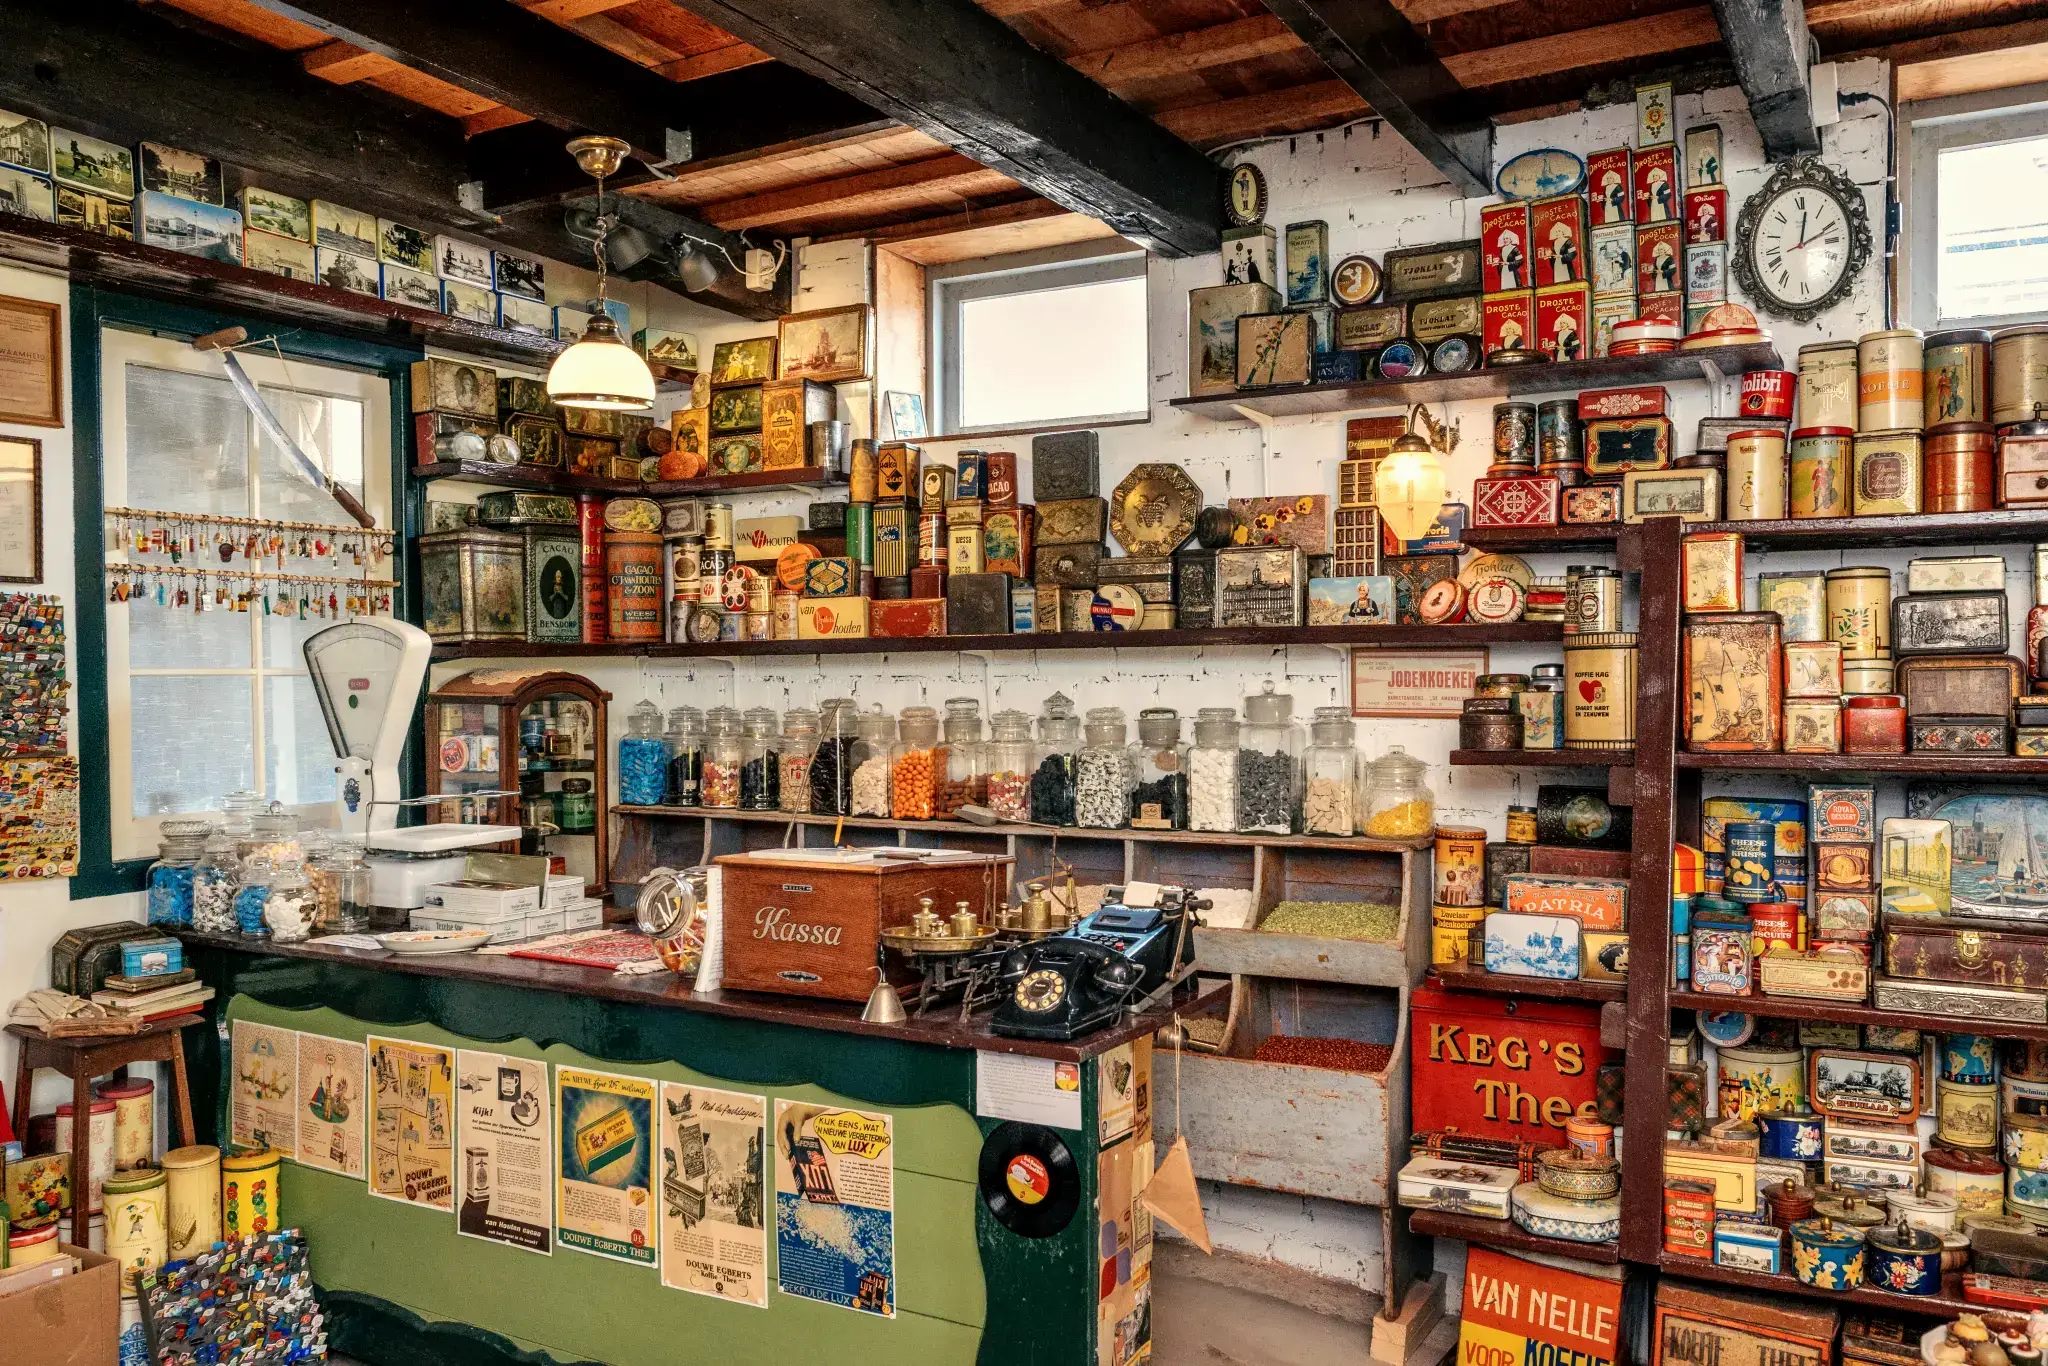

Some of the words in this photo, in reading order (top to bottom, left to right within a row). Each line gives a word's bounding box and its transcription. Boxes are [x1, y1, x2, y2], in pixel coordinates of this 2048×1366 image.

[1602, 161, 1627, 170] CACAO
[1647, 158, 1673, 167] CACAO
[1549, 211, 1578, 221] CACAO
[1498, 219, 1526, 229] CACAO
[1653, 233, 1679, 241] COCOA
[1403, 263, 1445, 276] TJOKLAT
[1539, 297, 1575, 308] DROSTE
[1486, 303, 1521, 314] DROSTE
[1555, 304, 1582, 313] CACAO
[1654, 305, 1680, 314] CACAO
[1501, 310, 1528, 319] CACAO
[736, 532, 752, 541] VAN
[766, 536, 796, 547] HOUTEN
[543, 545, 574, 555] CACAO
[624, 565, 655, 575] CACAO
[699, 560, 725, 570] ACAO
[800, 606, 815, 615] van
[540, 620, 577, 629] BENSDORP
[832, 612, 862, 634] houten
[1387, 670, 1476, 689] JODENKOEKEN
[1833, 805, 1854, 813] ROYAL
[1831, 813, 1857, 821] DESSERT
[1731, 838, 1768, 847] CHEESE
[1524, 898, 1605, 921] PATRIA
[752, 906, 843, 946] Kassa
[1429, 1022, 1585, 1075] KEG'S
[2012, 1085, 2046, 1096] Wilhelmina
[472, 1105, 494, 1117] Kijk!
[863, 1123, 880, 1133] WAT
[823, 1127, 848, 1138] NIEUWE
[848, 1131, 890, 1145] VERBETERING
[832, 1138, 847, 1149] VAN
[404, 1167, 433, 1183] DOUWE
[416, 1175, 448, 1192] EGBERTS
[426, 1185, 452, 1202] KOFFIE
[484, 1219, 498, 1227] van
[498, 1221, 521, 1232] Houten
[563, 1231, 592, 1247] DOUWE
[592, 1239, 627, 1254] EGBERTS
[629, 1246, 650, 1260] THEE
[685, 1259, 715, 1273] DOUWE
[716, 1264, 752, 1280] EGBERTS
[722, 1274, 737, 1284] Thee
[859, 1280, 873, 1293] LUX
[781, 1282, 830, 1301] GEKRULDE
[830, 1293, 851, 1306] LUX
[1470, 1272, 1520, 1319] VAN
[1528, 1288, 1614, 1345] NELLE
[1465, 1340, 1515, 1366] VOOR
[1523, 1337, 1611, 1366] KOFF
